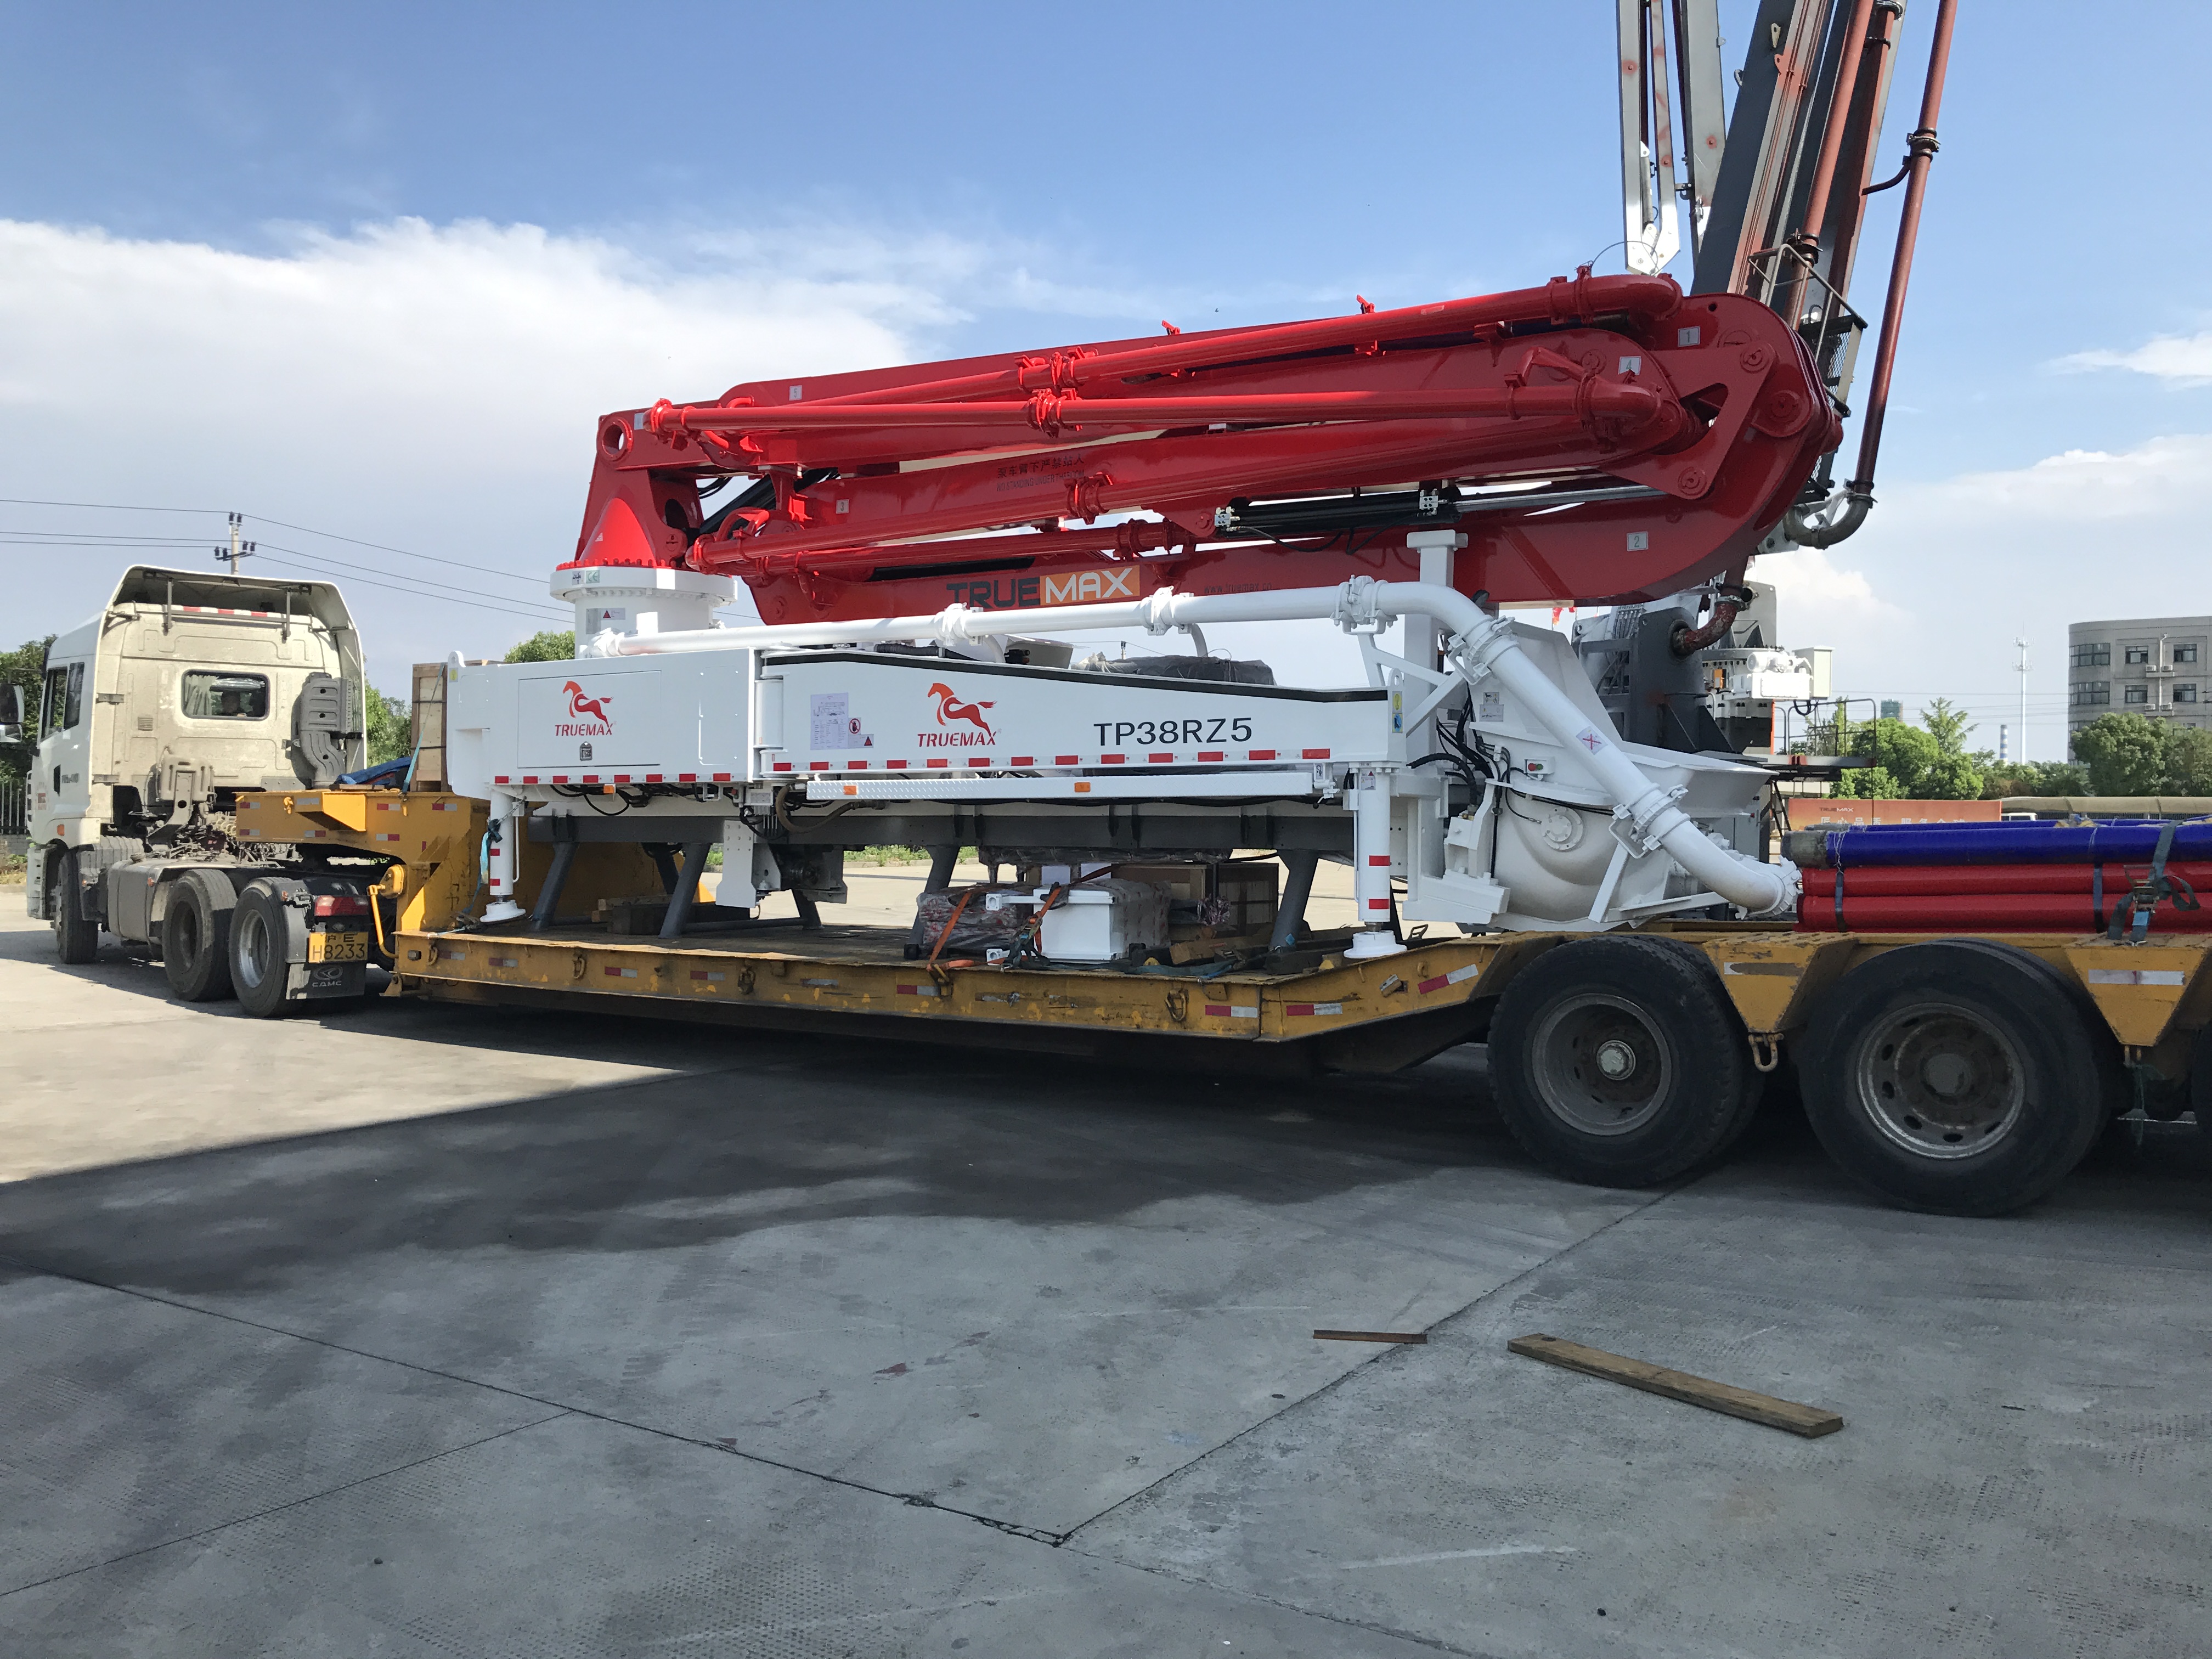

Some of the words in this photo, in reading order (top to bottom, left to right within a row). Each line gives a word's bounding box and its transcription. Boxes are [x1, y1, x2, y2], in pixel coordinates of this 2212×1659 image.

[1626, 359, 1632, 370] 4
[793, 388, 798, 398] 5
[1634, 535, 1640, 548] 2
[555, 723, 613, 736] TRUEMAX
[1093, 717, 1252, 746] TP38RZ5
[917, 731, 997, 747] TRUEMAX
[312, 943, 365, 961] H8233
